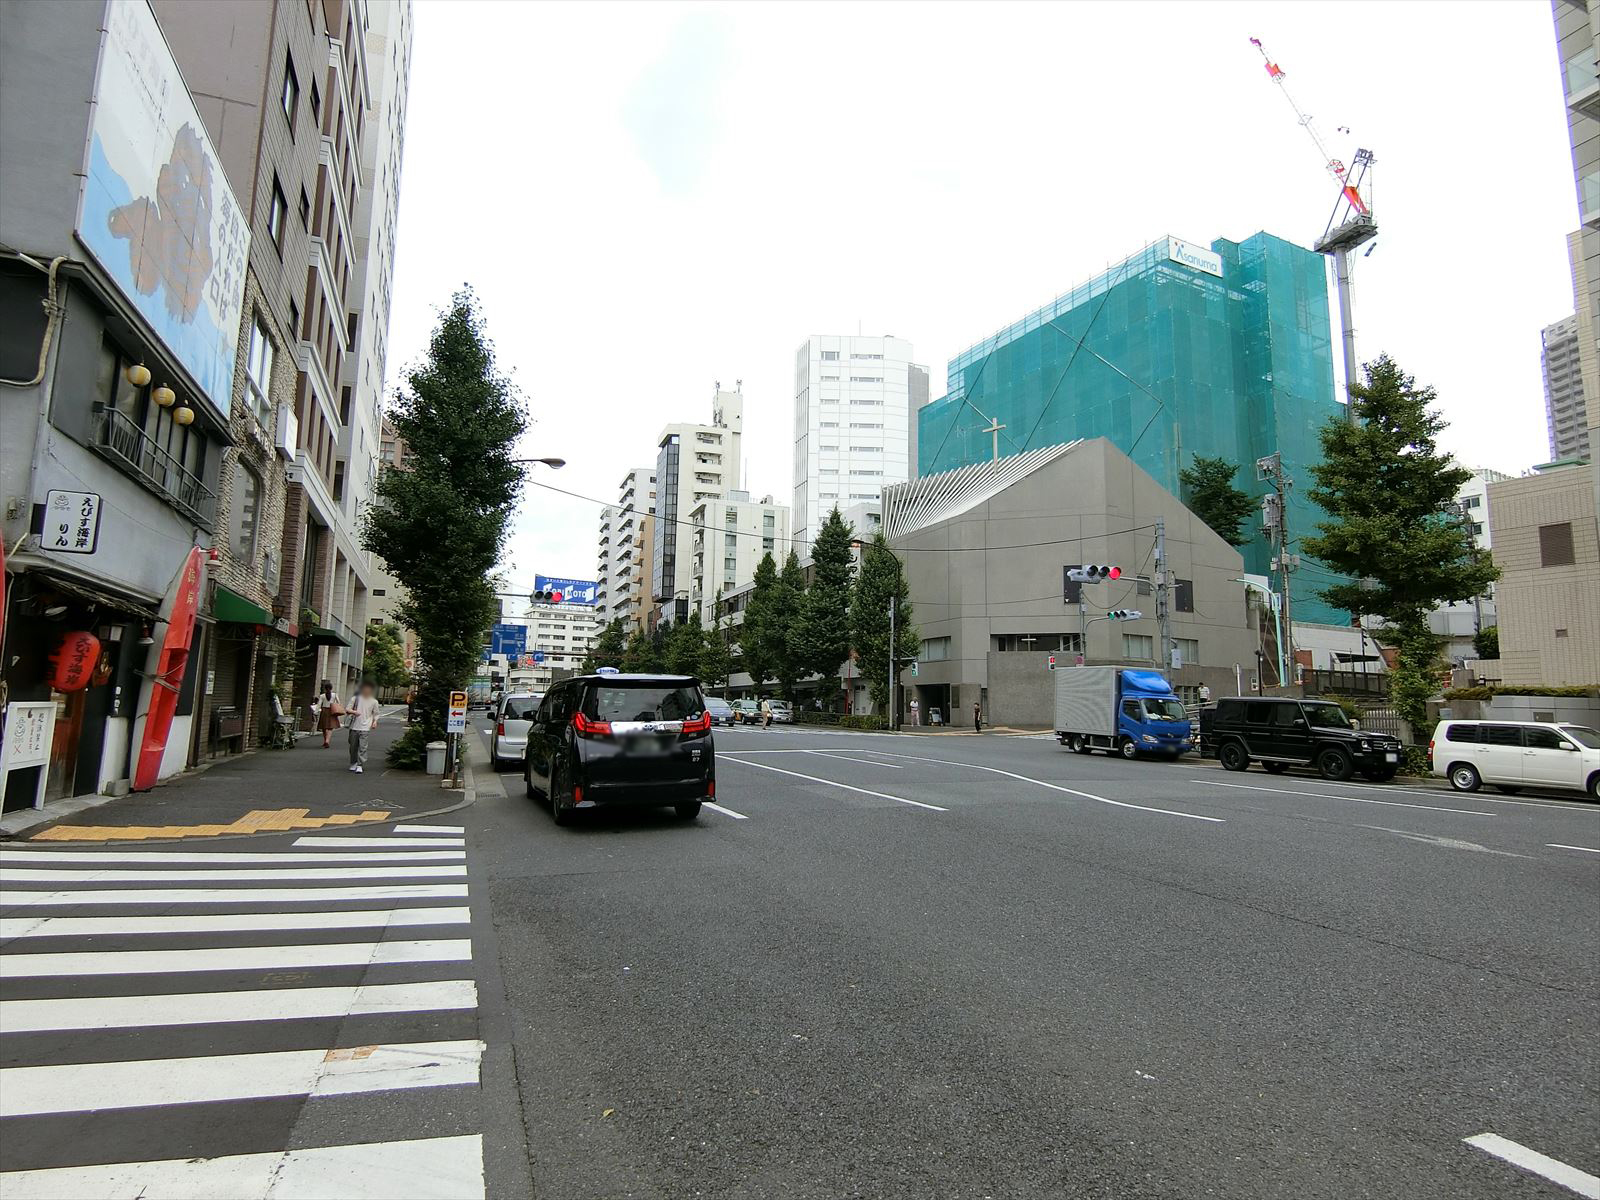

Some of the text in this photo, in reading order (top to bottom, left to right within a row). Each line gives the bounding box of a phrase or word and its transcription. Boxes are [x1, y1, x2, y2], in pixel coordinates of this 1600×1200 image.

[1176, 245, 1217, 271] Asanuma
[56, 523, 68, 546] りん
[75, 497, 93, 548] えびす海岸
[452, 693, 465, 705] P
